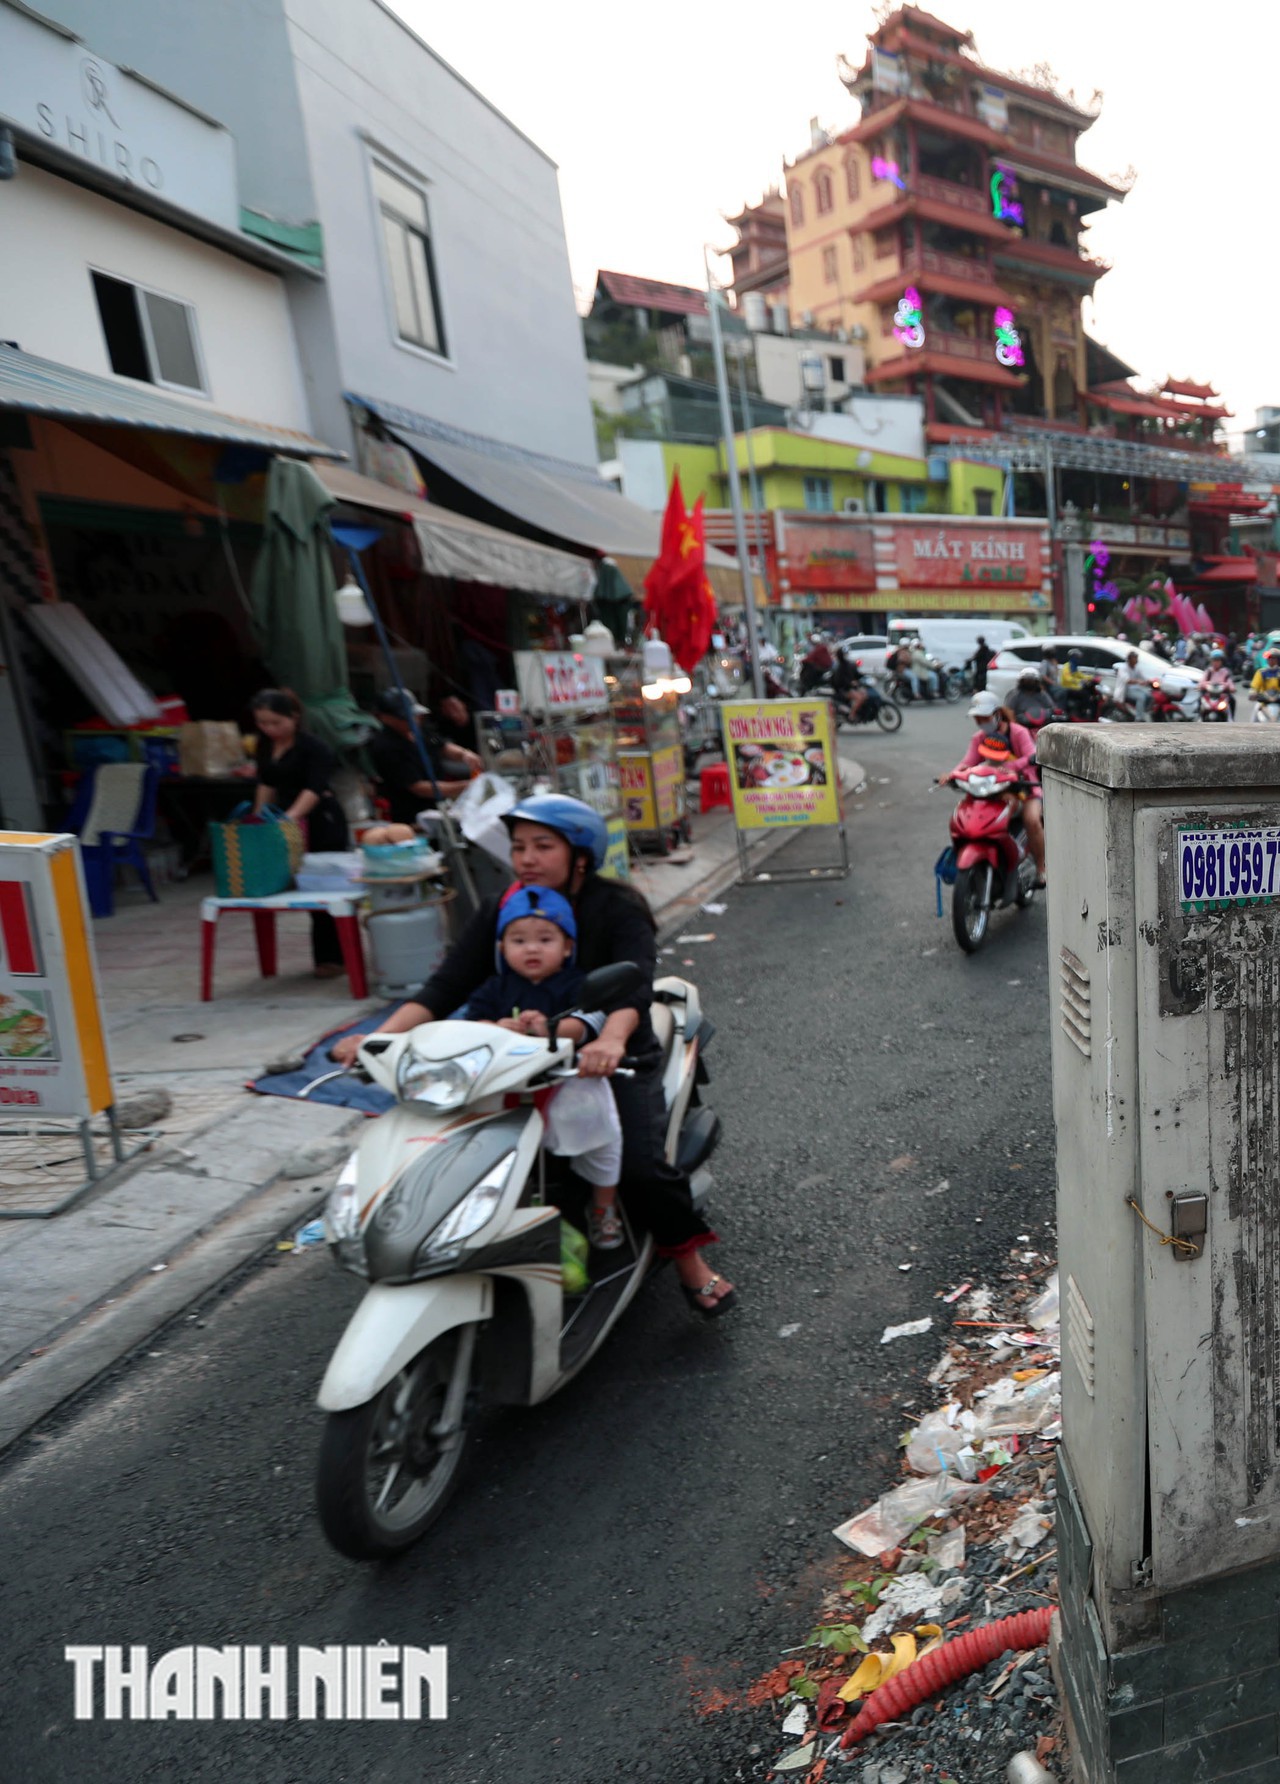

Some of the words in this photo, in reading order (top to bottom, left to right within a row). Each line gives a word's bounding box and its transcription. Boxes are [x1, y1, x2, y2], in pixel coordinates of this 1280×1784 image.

[36, 102, 165, 190] SHIRO
[913, 532, 963, 559] MẮT
[970, 536, 1026, 560] KÍNH
[798, 711, 817, 735] 5
